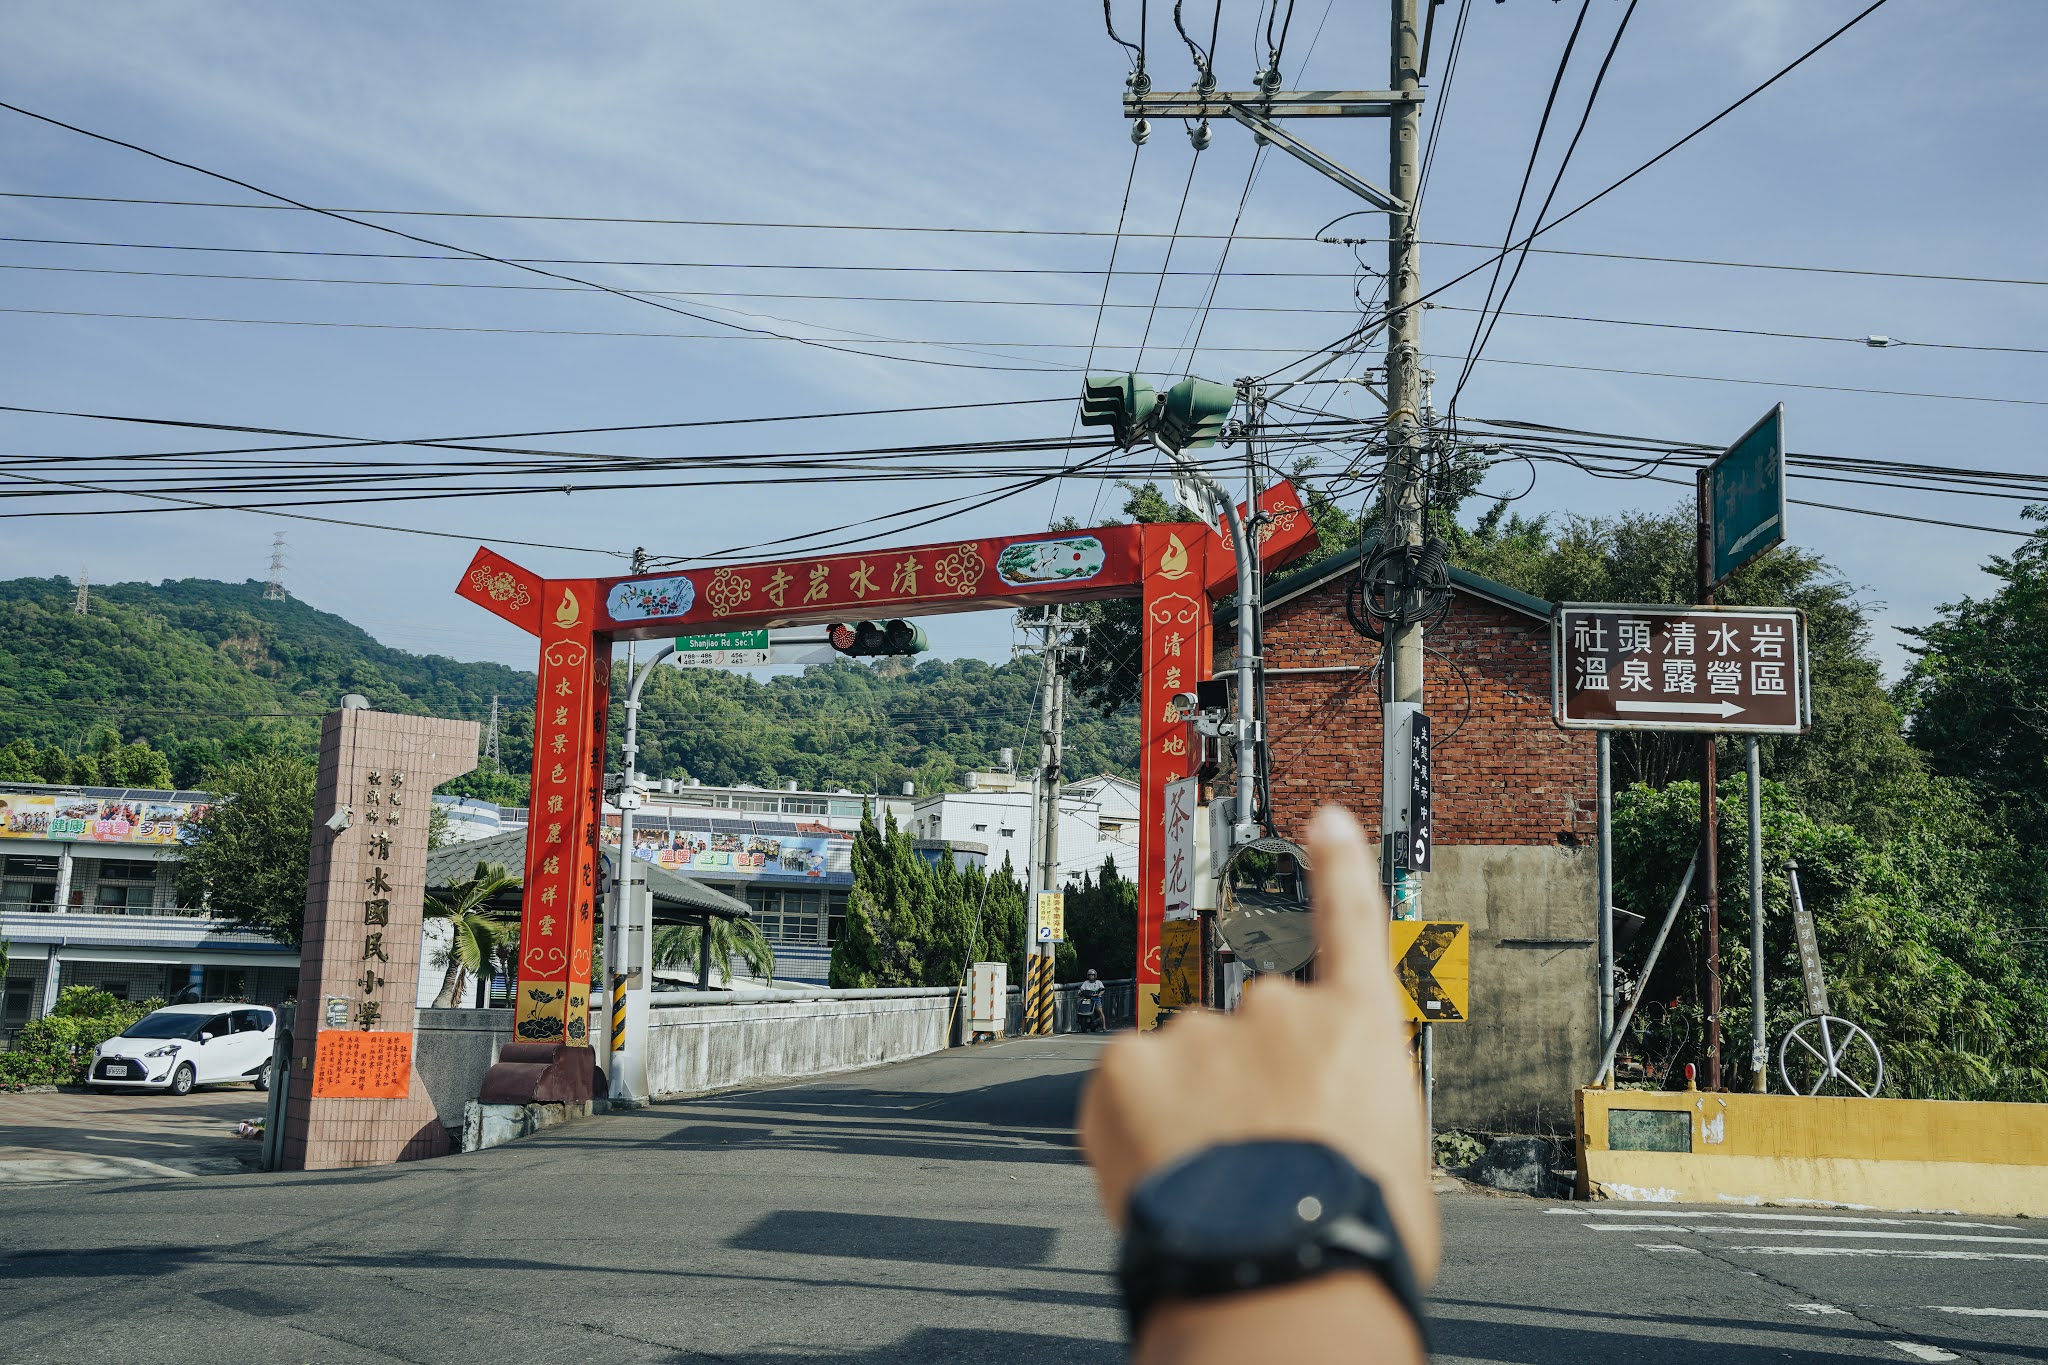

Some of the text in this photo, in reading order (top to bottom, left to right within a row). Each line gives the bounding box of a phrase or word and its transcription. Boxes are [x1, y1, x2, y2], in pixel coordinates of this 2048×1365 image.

[689, 639, 719, 650] Shanjiao
[721, 639, 732, 647] Rd.
[1574, 619, 1786, 659] 社頭清水岩
[1575, 657, 1787, 695] 溫泉露營區
[1412, 735, 1420, 794] 清水岩
[365, 770, 382, 827] 社頭鄉
[386, 770, 405, 827] 彰化縣
[538, 676, 574, 937] 水岩景色雅麗結祥雲
[51, 818, 86, 833] 健康
[96, 820, 130, 834] 快樂
[140, 821, 173, 836] 多元
[1168, 786, 1190, 895] 茶花
[661, 849, 692, 863] 溫暖
[737, 852, 766, 867] 優質
[354, 831, 393, 1032] 清水國民小學
